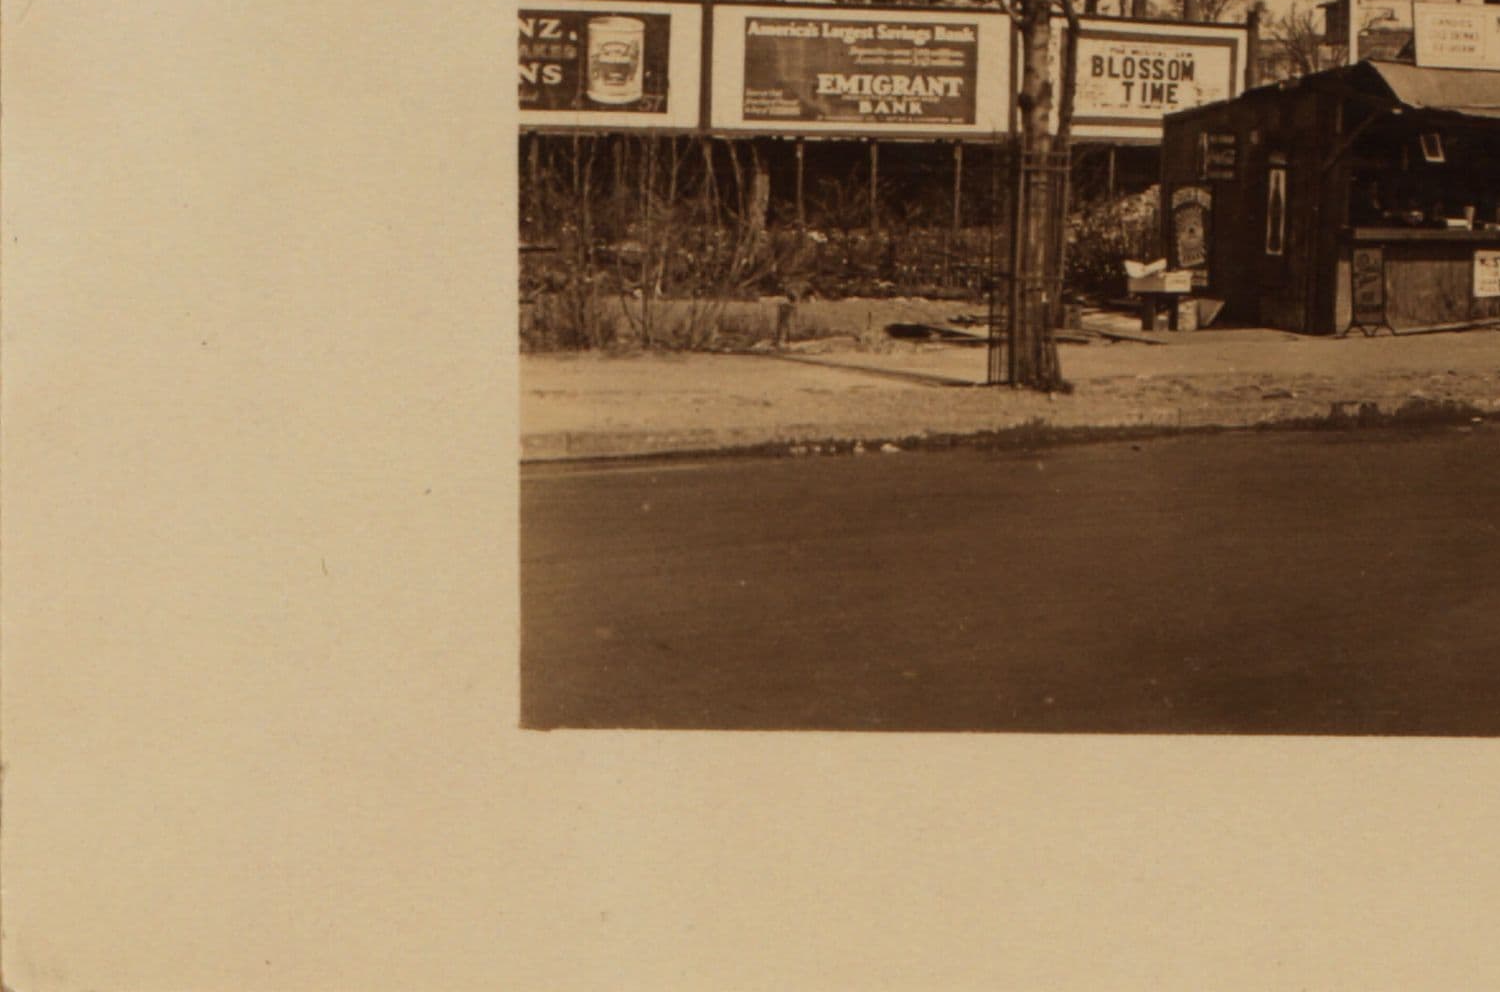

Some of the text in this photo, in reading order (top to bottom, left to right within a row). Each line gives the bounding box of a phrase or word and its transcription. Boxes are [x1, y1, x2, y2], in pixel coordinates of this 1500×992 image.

[747, 21, 976, 45] America's Largest Savings Bank
[1091, 54, 1195, 82] BLOSSOM
[816, 73, 964, 97] EMIGRANT
[1121, 81, 1179, 105] TIME
[858, 100, 923, 115] BANK
